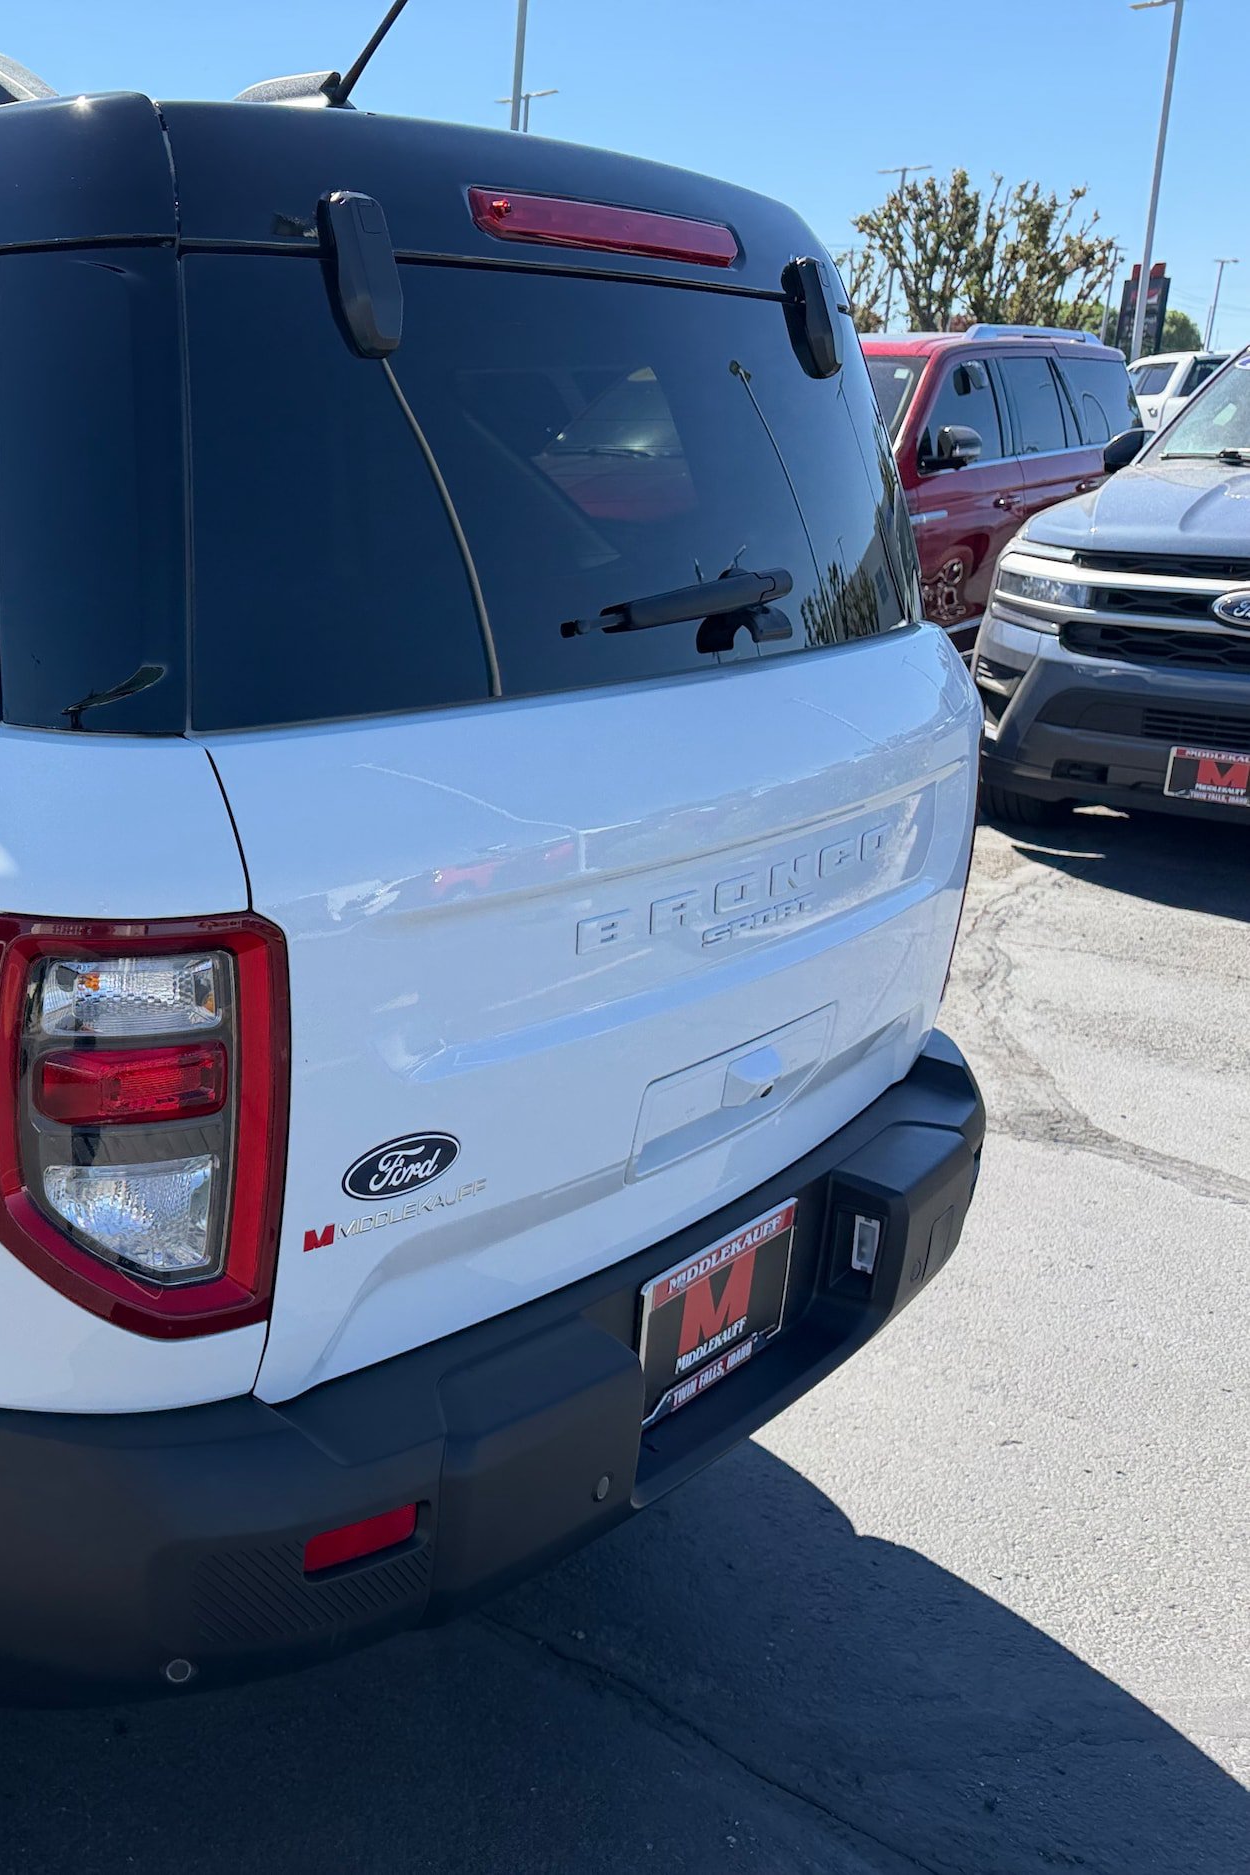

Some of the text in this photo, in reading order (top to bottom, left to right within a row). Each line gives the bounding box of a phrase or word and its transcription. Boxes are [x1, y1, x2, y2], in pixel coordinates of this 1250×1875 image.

[1197, 758, 1250, 788] M
[576, 824, 890, 955] BRONCO
[701, 891, 814, 948] SPORT
[369, 1144, 442, 1192] Ford
[337, 1178, 487, 1240] MIDDLEKAUFF
[667, 1215, 782, 1295] MIDDLEKAUFF
[676, 1248, 757, 1356] M
[673, 1341, 753, 1407] TWIN FALLS, IDAHO
[674, 1316, 748, 1375] MIDDLEKAUFF
